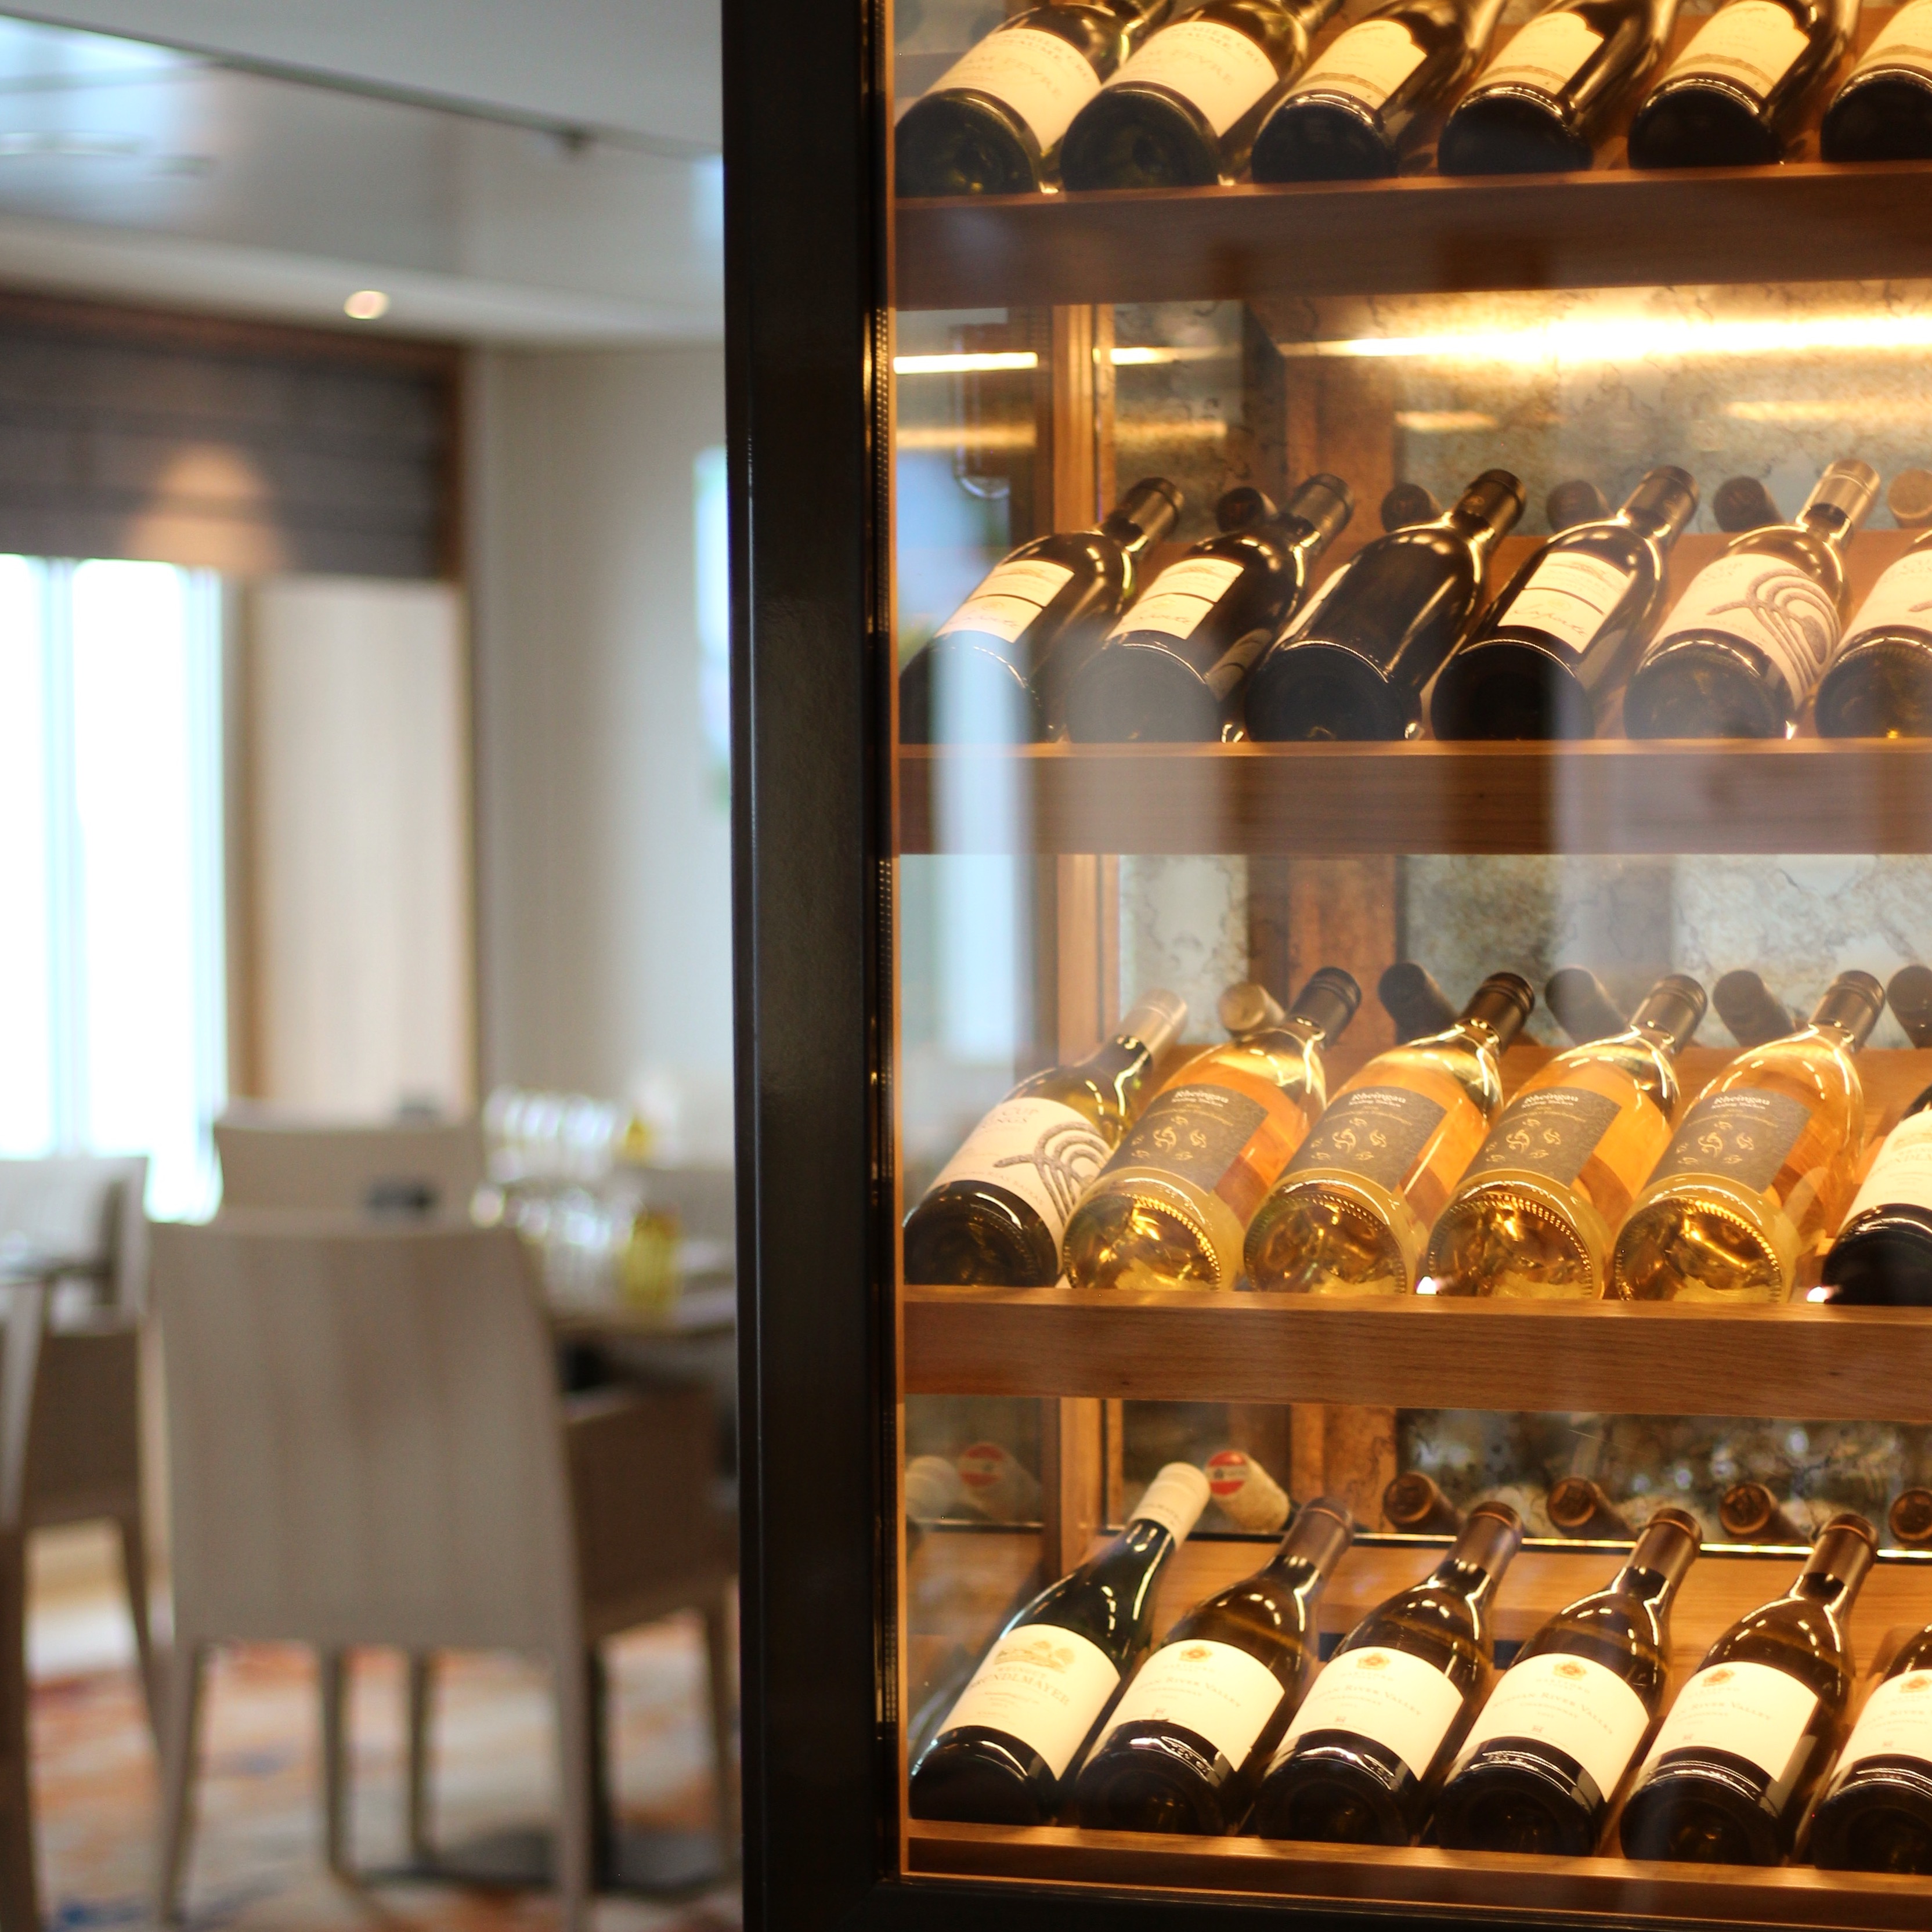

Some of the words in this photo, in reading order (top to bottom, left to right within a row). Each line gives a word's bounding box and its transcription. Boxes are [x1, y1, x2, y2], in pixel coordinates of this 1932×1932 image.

[1166, 1676, 1200, 1687] RIVER
[1205, 1682, 1241, 1708] VALLEY
[1344, 1684, 1380, 1696] RIVER
[1384, 1691, 1422, 1716] VALLEY
[1541, 1692, 1576, 1707] RIVER
[1580, 1704, 1613, 1735] VALLEY
[1691, 1702, 1725, 1710] RIVER
[1731, 1701, 1771, 1720] VALLEY
